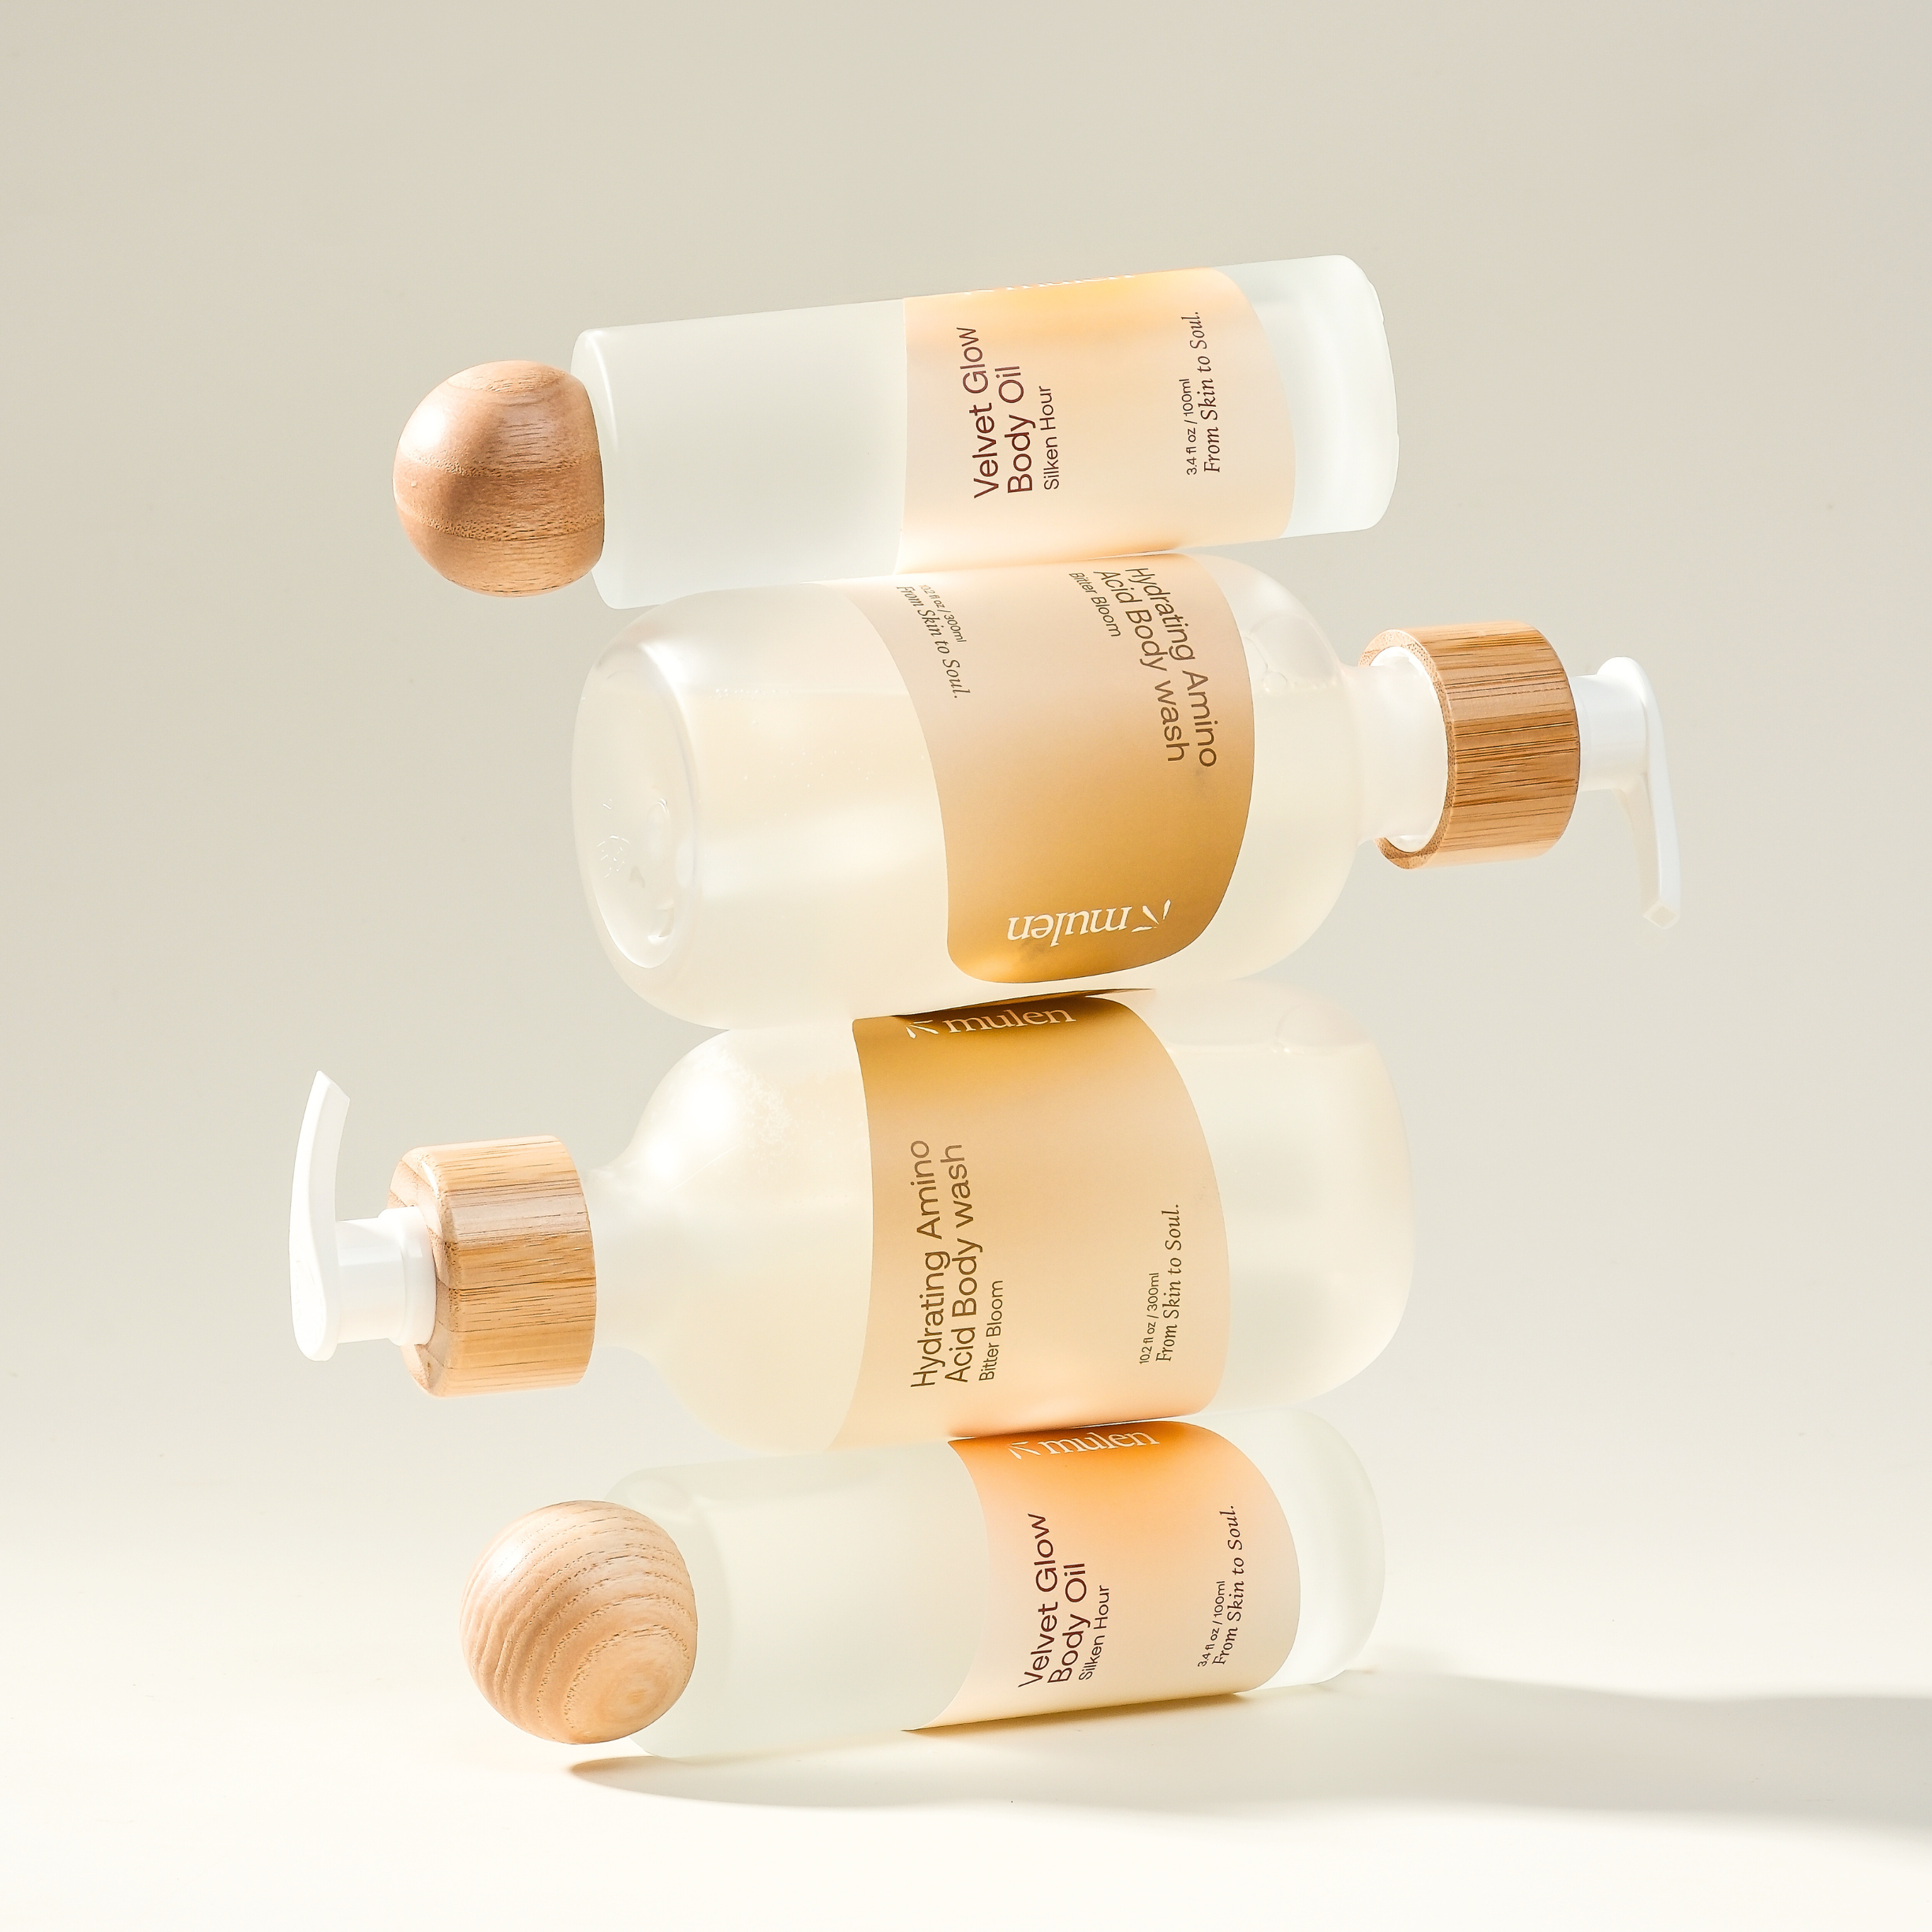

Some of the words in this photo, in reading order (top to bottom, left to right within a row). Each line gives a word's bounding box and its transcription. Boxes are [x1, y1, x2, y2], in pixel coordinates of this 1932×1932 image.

[1181, 311, 1207, 349] Soul.
[957, 327, 988, 393] Glow
[1197, 356, 1211, 372] to
[994, 365, 1024, 404] Oil
[1179, 379, 1194, 416] 100ml
[1196, 379, 1218, 420] Skin
[1039, 386, 1054, 430] Hour
[968, 403, 999, 498] Velvet
[1004, 415, 1035, 493] Body
[1188, 427, 1196, 442] oz
[1203, 427, 1221, 472] From
[1044, 437, 1060, 490] Silken
[1186, 457, 1197, 475] 3.4
[1069, 573, 1098, 594] Bitter
[1091, 597, 1121, 636] Bloom
[896, 586, 924, 607] From
[917, 610, 944, 636] Skin
[934, 640, 949, 654] to
[942, 659, 971, 698] Soul.
[944, 614, 967, 642] 300ml
[1093, 571, 1143, 603] Acid
[1125, 610, 1168, 671] Body
[1154, 681, 1190, 761] wash
[1125, 568, 1196, 660] Hydrating
[1182, 670, 1218, 767] Amino
[1007, 906, 1132, 947] mulen
[942, 1009, 1076, 1033] mulen
[910, 1140, 942, 1240] Amino
[940, 1144, 974, 1228] wash
[1162, 1204, 1182, 1251] Soul.
[951, 1237, 983, 1318] Body
[1168, 1257, 1182, 1275] to
[986, 1280, 1003, 1337] Bloom
[1147, 1272, 1158, 1311] 300ml
[1162, 1281, 1180, 1318] Skin
[911, 1251, 950, 1387] Hydrating
[1147, 1322, 1156, 1334] oz
[944, 1326, 976, 1383] Acid
[979, 1342, 1000, 1381] Bitter
[1139, 1346, 1152, 1364] 10.2
[1156, 1324, 1177, 1362] From
[1038, 1432, 1160, 1455] mulen
[1219, 1505, 1243, 1550] Soul.
[1028, 1513, 1057, 1592] Glow
[1232, 1557, 1244, 1575] to
[1063, 1562, 1087, 1602] Oil
[1213, 1580, 1225, 1618] 100ml
[1227, 1581, 1244, 1621] Skin
[1017, 1602, 1058, 1688] Velvet
[1047, 1613, 1091, 1684] Body
[1078, 1635, 1106, 1680] Silken
[1093, 1585, 1110, 1629] Hour
[1210, 1627, 1219, 1641] oz
[1212, 1627, 1238, 1665] From
[1198, 1652, 1211, 1667] 3.4
